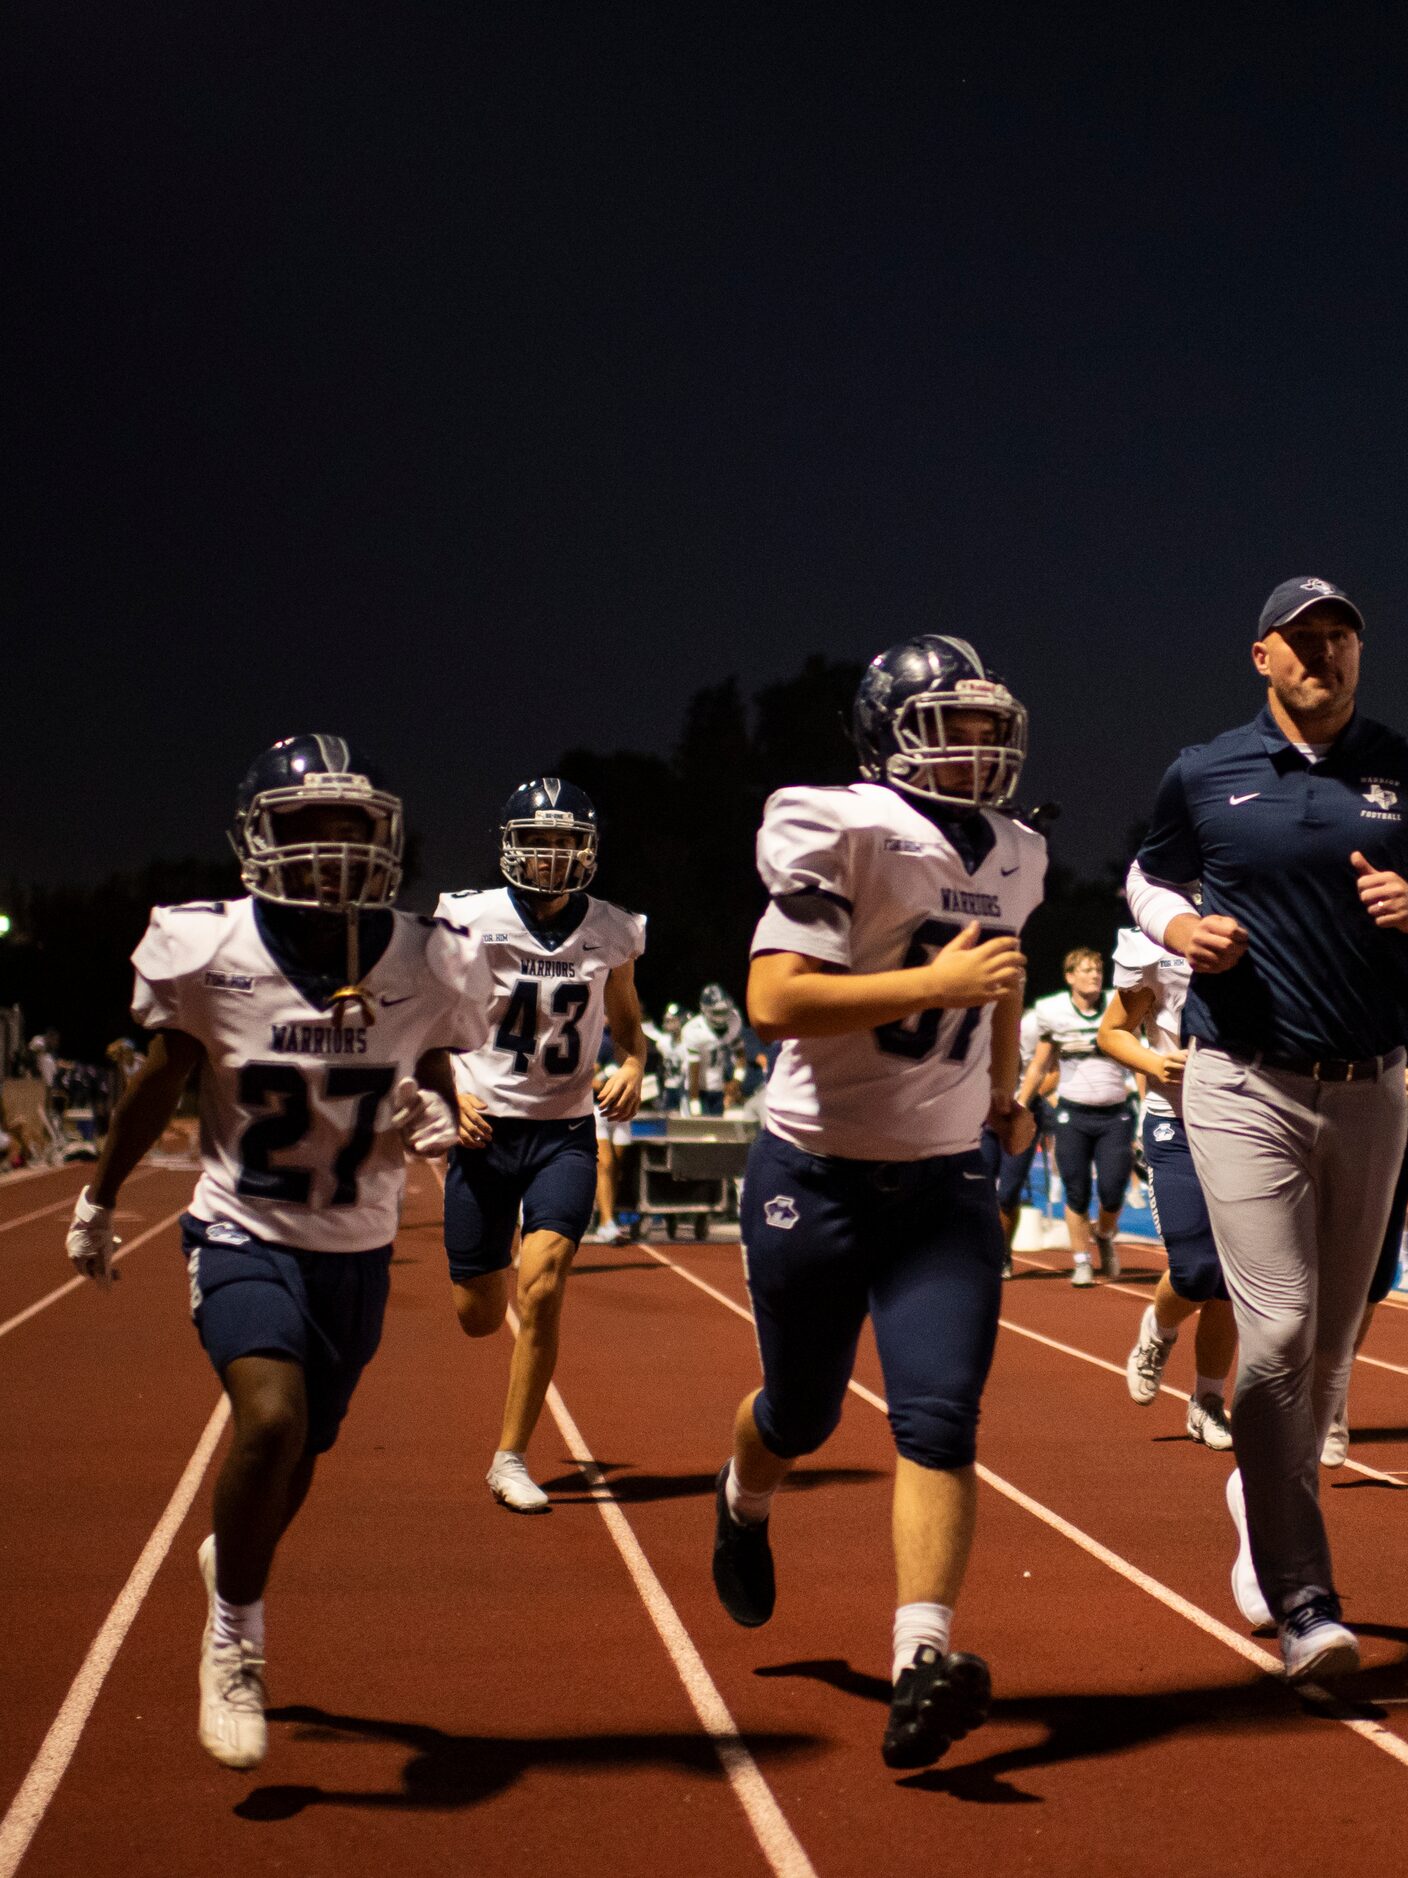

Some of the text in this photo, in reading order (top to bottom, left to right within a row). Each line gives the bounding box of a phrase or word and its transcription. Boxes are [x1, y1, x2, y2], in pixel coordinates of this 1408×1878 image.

[1360, 810, 1402, 821] FOOTBALL
[941, 887, 1001, 917] WARRIORS
[520, 959, 576, 978] WARRIORS
[270, 1024, 367, 1054] WARRIORS
[493, 980, 591, 1076] 43
[235, 1062, 398, 1207] 27
